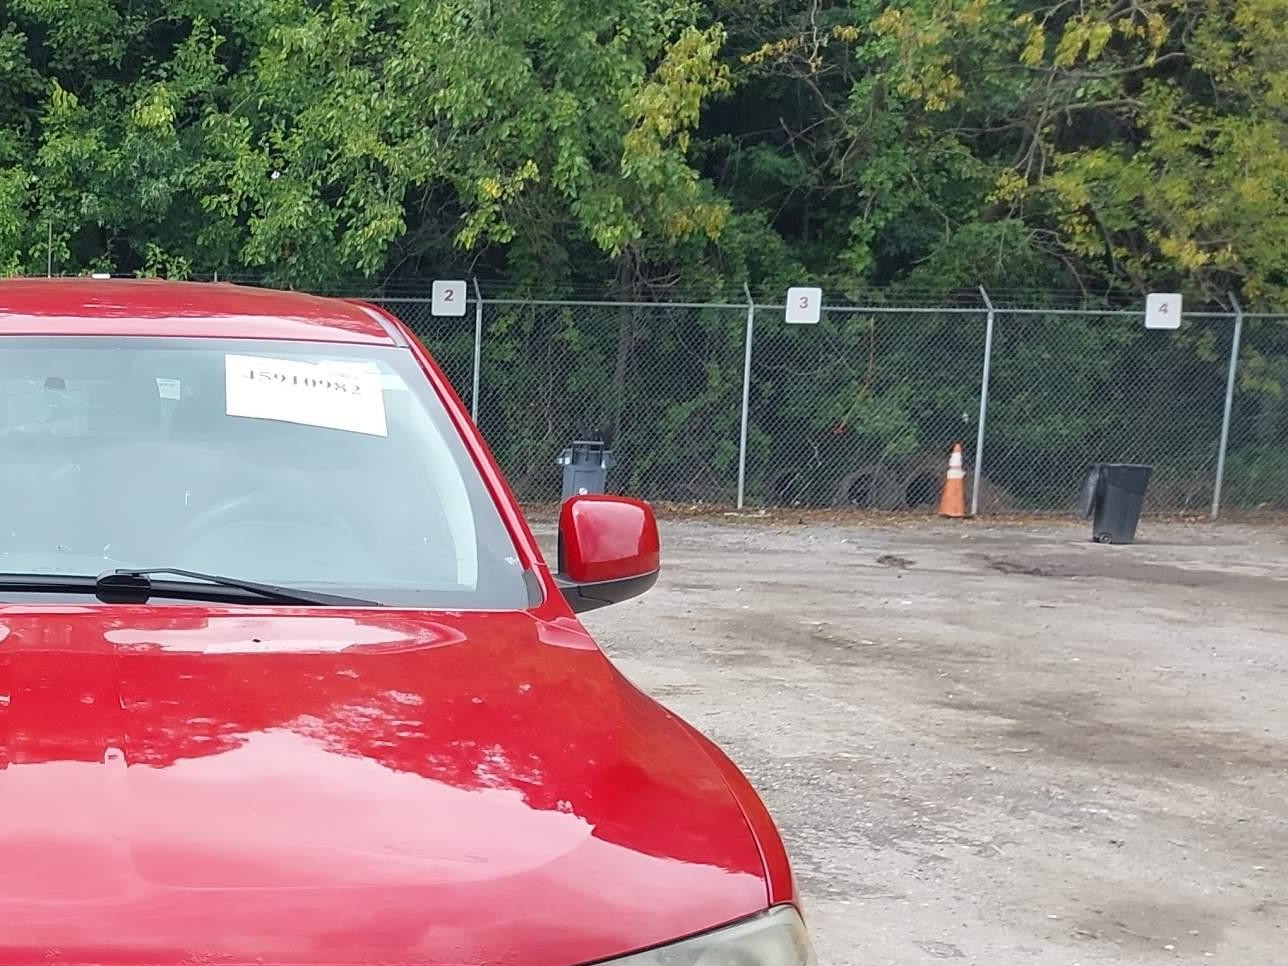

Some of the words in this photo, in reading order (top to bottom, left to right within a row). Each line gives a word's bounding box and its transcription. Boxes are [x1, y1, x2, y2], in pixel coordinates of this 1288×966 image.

[444, 289, 454, 302] 2
[799, 296, 809, 309] 3
[1158, 302, 1168, 314] 4
[241, 369, 362, 396] 45910982
